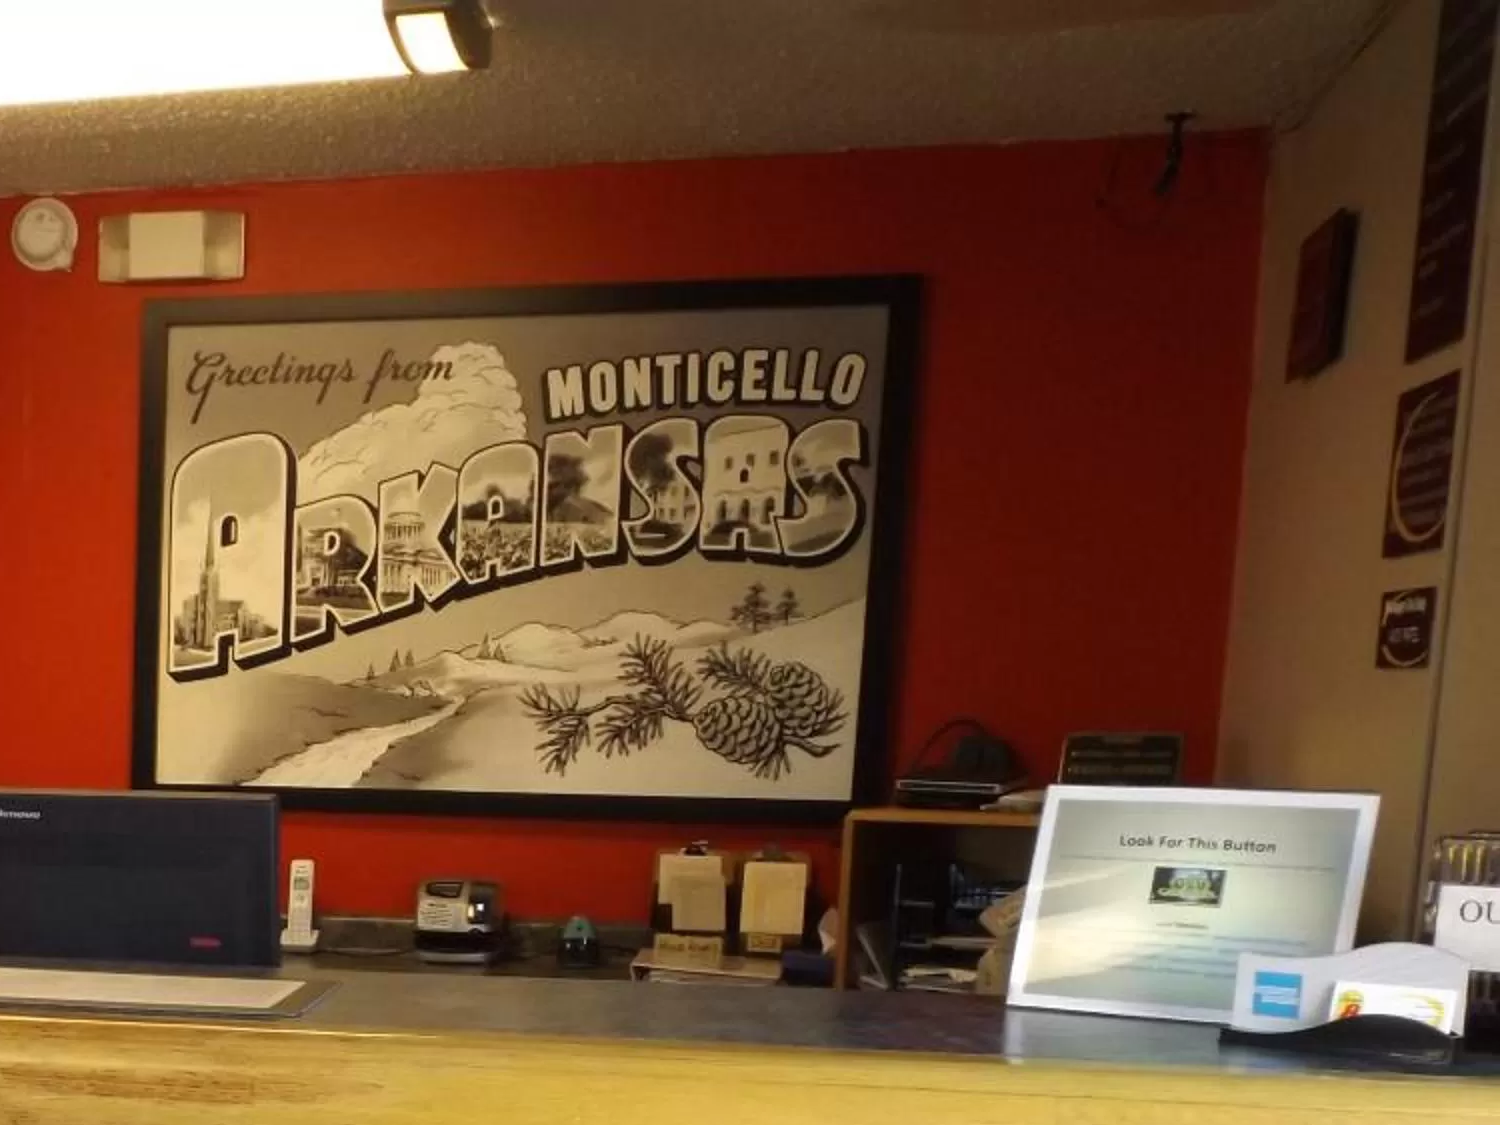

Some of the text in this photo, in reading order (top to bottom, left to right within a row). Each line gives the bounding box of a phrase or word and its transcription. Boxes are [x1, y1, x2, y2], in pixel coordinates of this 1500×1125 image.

[185, 349, 453, 424] Greetings from
[544, 348, 868, 421] MONTICELLO
[168, 415, 870, 683] ARKANSAS
[0, 808, 41, 819] lenovo
[1119, 835, 1277, 853] Look For This Button
